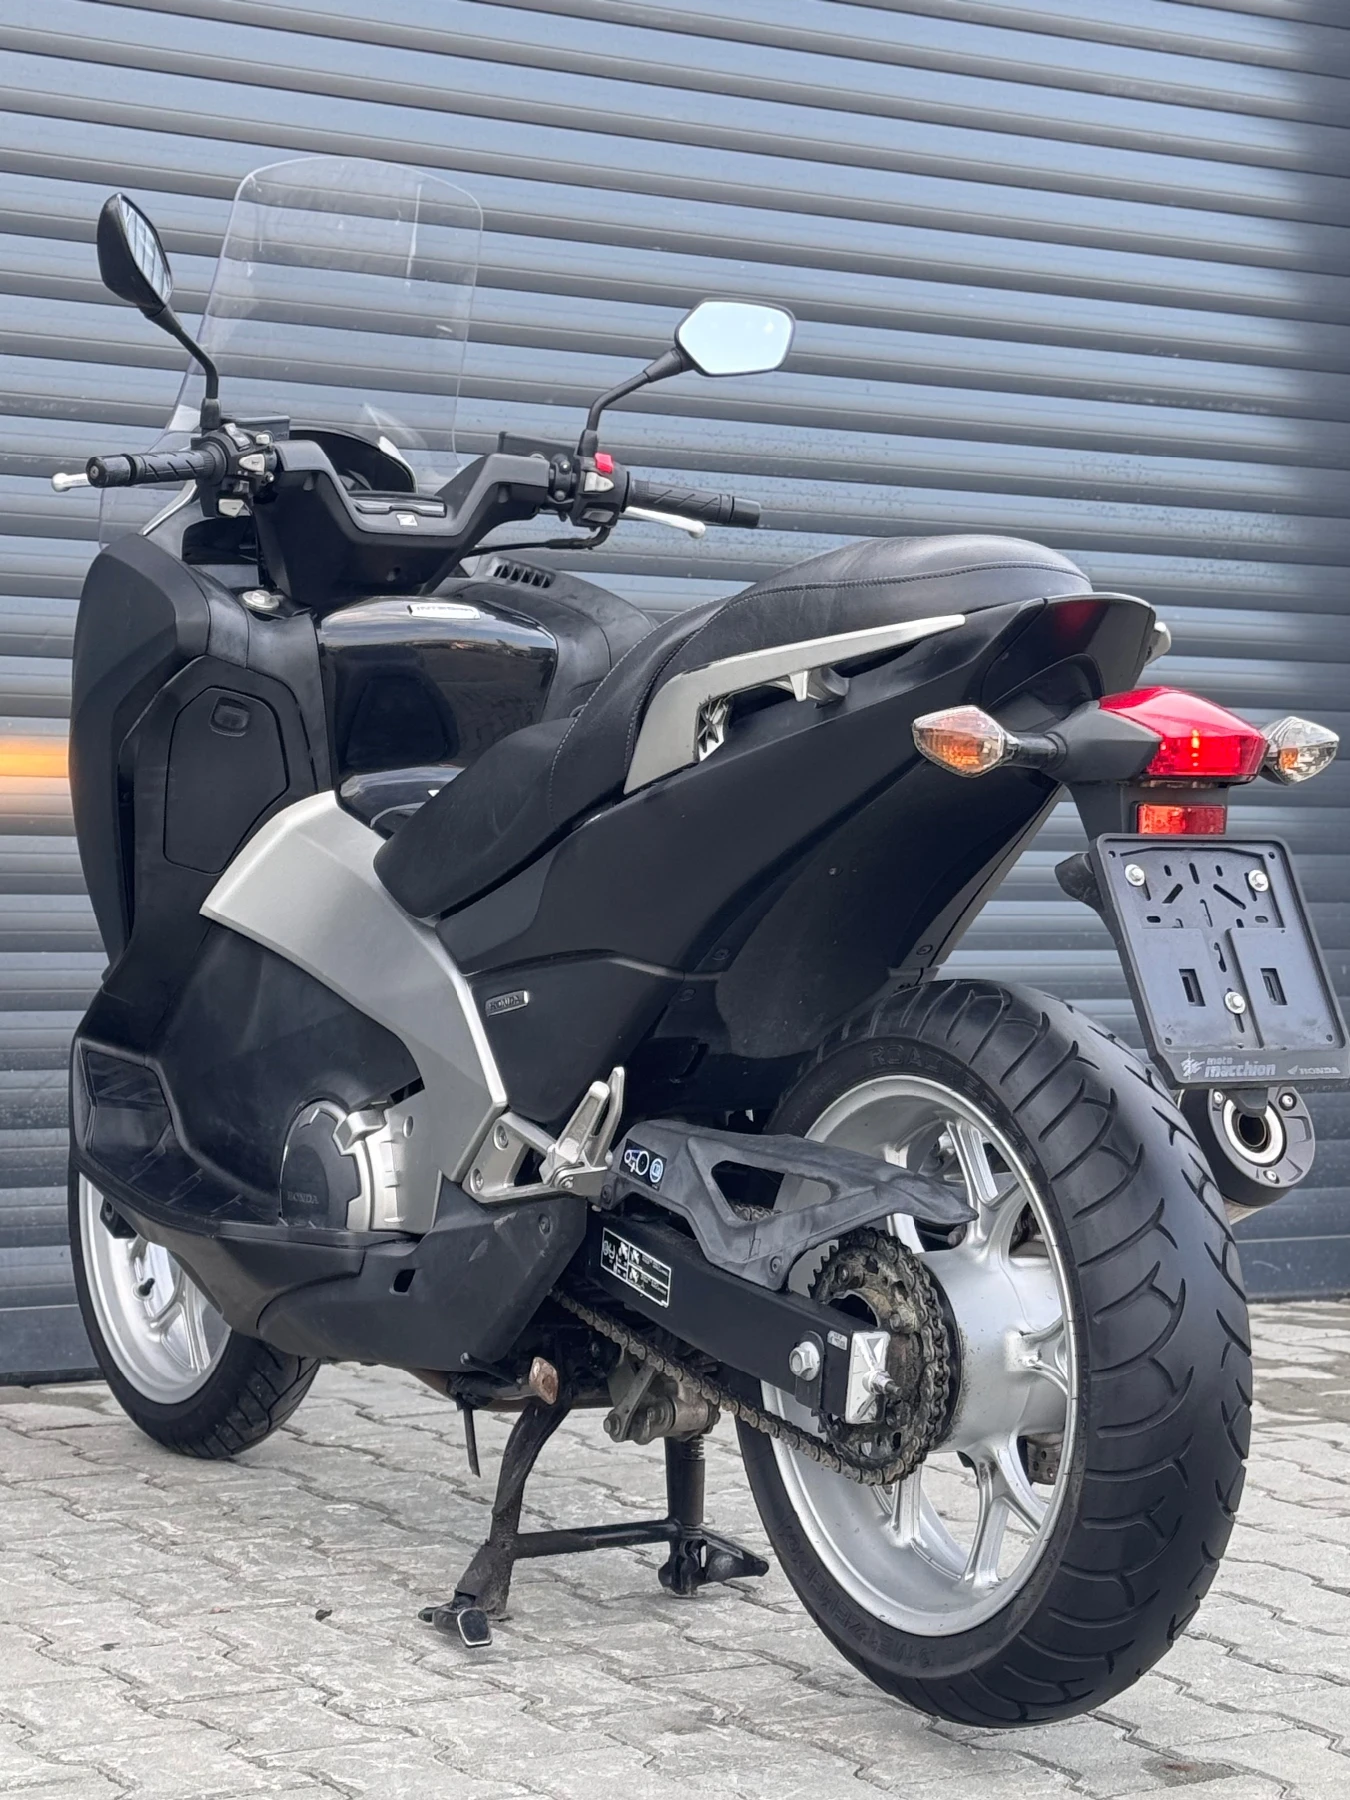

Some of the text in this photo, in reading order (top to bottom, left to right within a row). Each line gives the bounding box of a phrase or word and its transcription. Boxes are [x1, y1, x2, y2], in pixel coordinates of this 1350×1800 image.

[489, 995, 521, 1011] HONDA
[1206, 1058, 1233, 1066] moto
[1204, 1061, 1277, 1078] macchion
[1299, 1067, 1342, 1076] HONDA
[287, 1193, 319, 1204] HONDA
